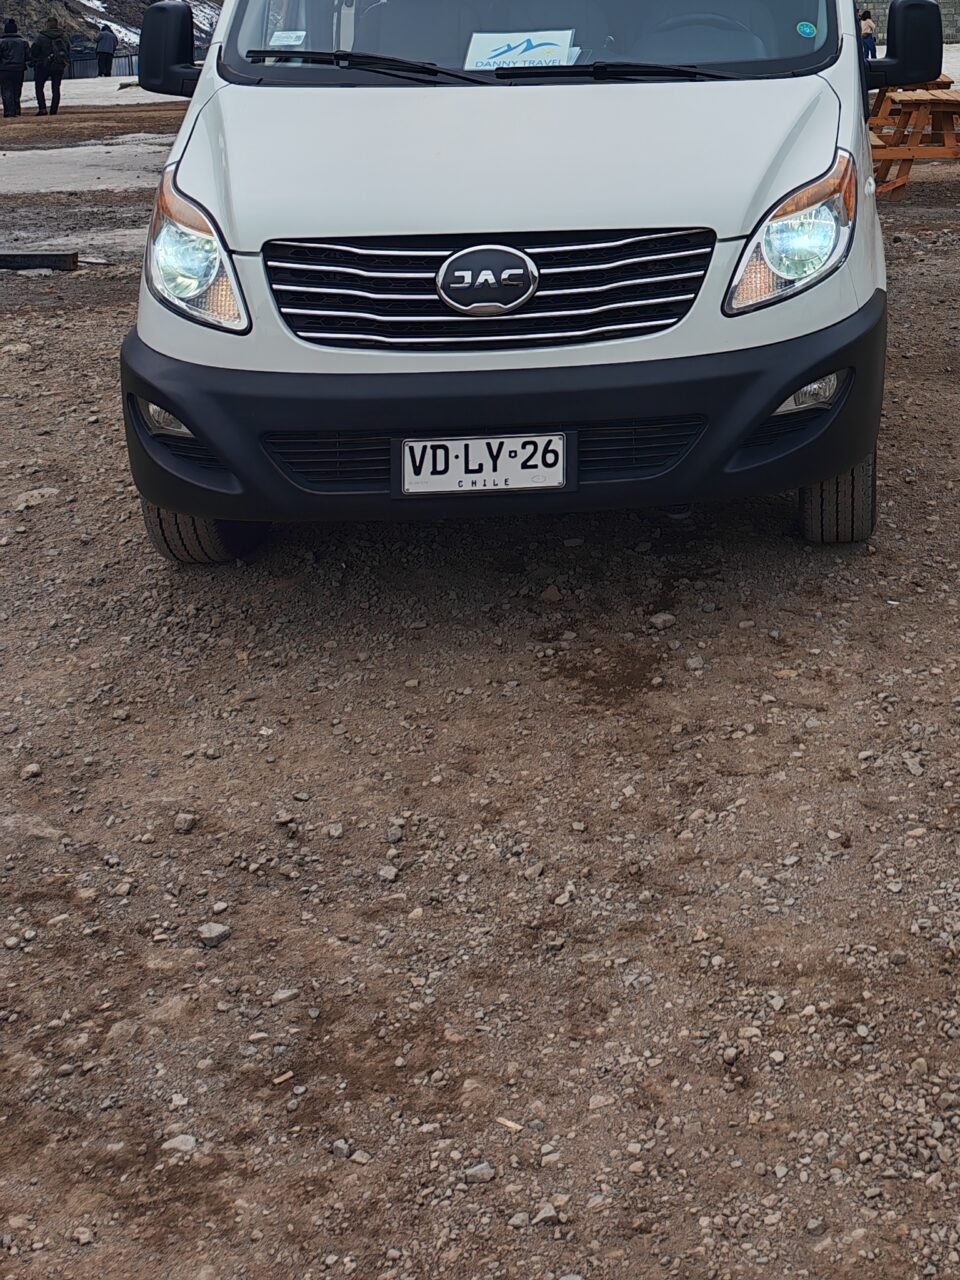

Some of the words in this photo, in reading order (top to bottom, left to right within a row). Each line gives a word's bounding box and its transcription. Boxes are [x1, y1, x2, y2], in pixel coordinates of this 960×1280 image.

[475, 60, 519, 68] DANNY
[450, 269, 524, 289] JAC
[457, 477, 511, 488] CHILE
